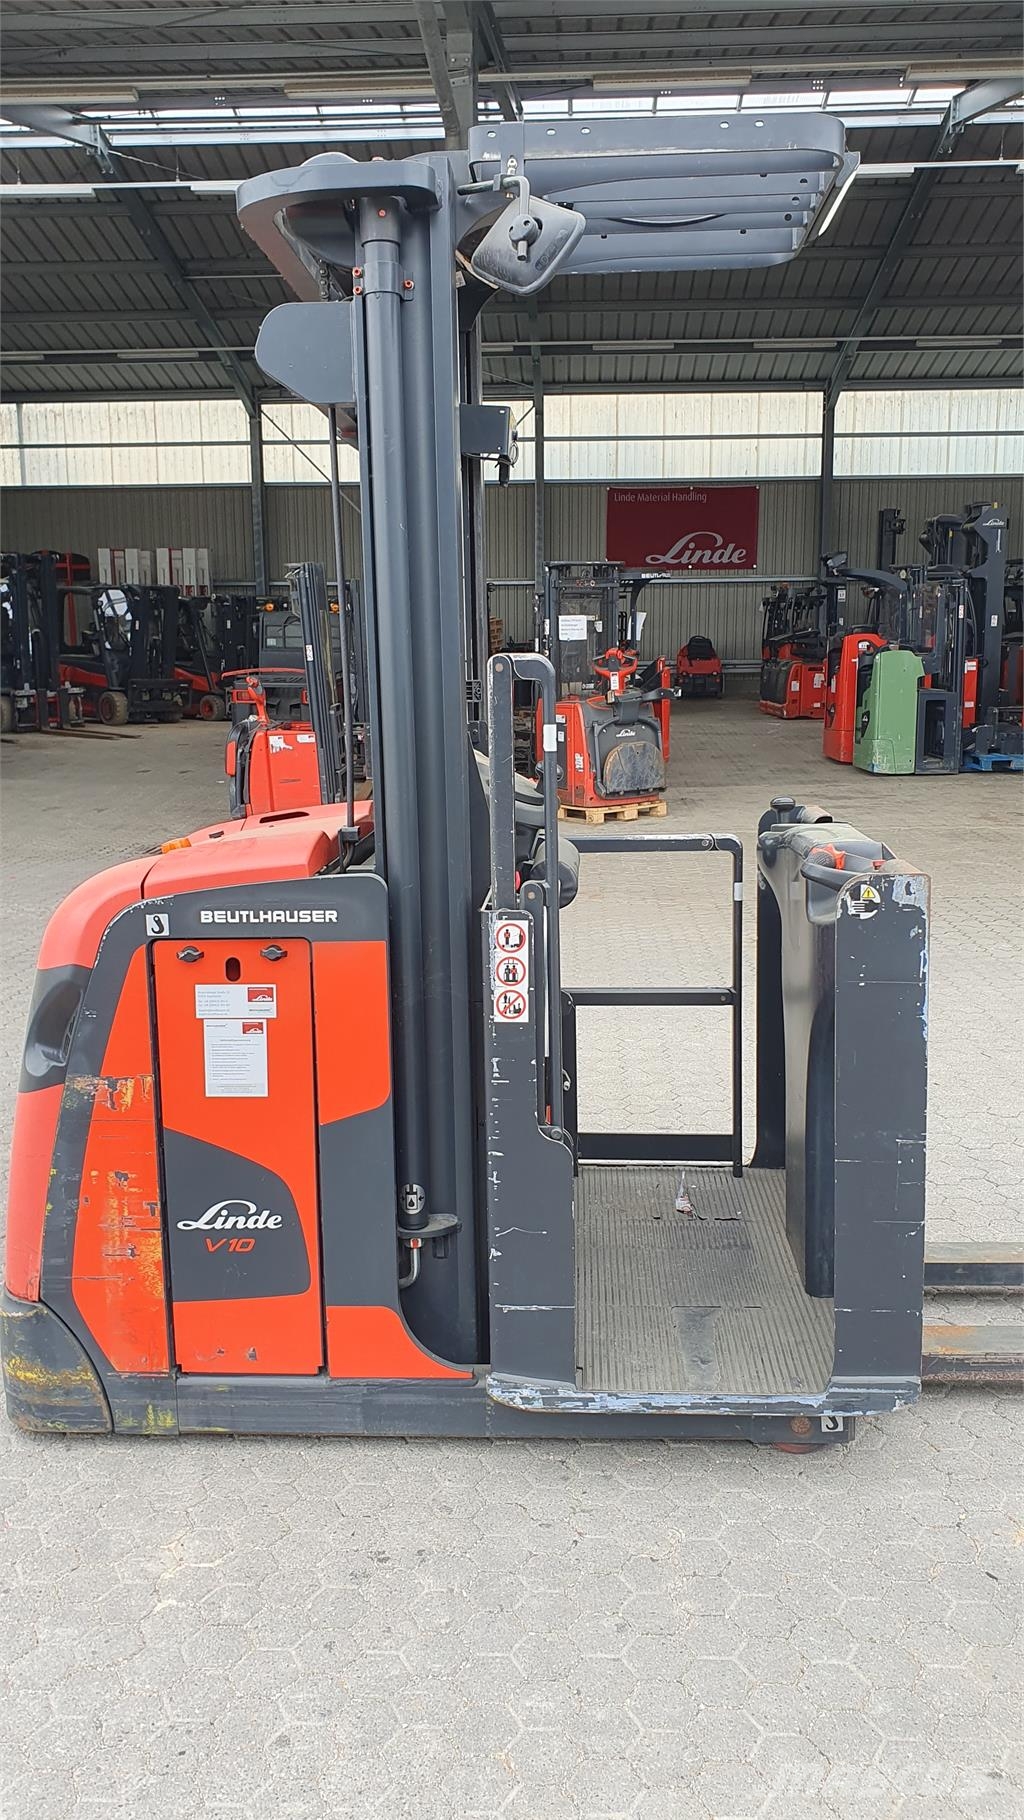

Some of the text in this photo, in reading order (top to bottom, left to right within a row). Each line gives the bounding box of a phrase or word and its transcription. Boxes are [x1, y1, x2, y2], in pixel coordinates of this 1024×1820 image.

[614, 491, 707, 504] Linde Material Handling
[645, 531, 747, 564] Linde
[616, 728, 636, 737] Linde
[200, 910, 338, 923] BEUTLHAUSER
[177, 1200, 283, 1230] Linde
[205, 1238, 256, 1253] V10
